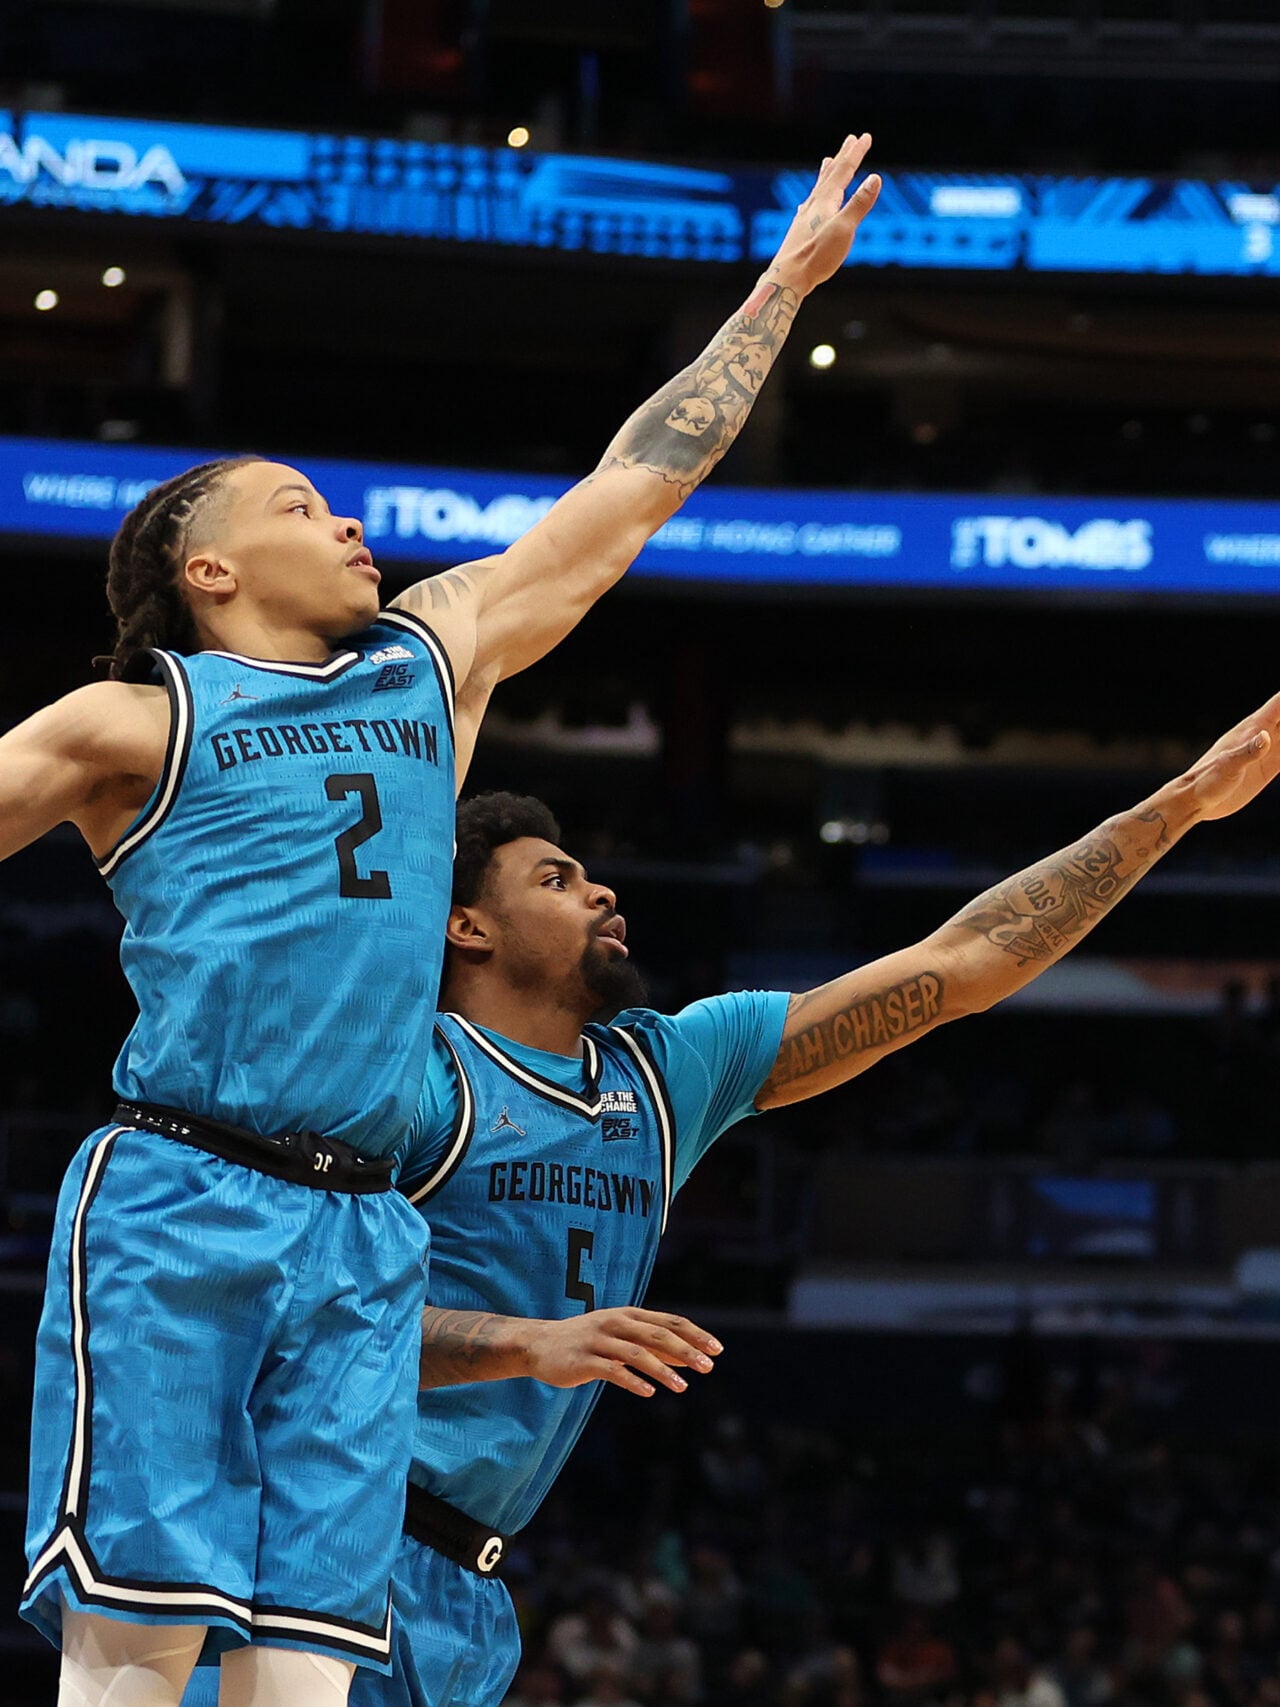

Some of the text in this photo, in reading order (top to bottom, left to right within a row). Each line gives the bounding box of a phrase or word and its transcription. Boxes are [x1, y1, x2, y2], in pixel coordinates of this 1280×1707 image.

[380, 664, 408, 676] BIG
[374, 675, 415, 687] EAST
[211, 718, 438, 771] GEORGETOWN
[324, 773, 392, 899] 2
[1020, 874, 1057, 911] STOP
[832, 973, 942, 1056] CHASER
[600, 1091, 635, 1102] BE THE
[600, 1101, 637, 1113] CHANGE
[602, 1118, 631, 1129] BIG
[602, 1127, 639, 1137] EAST
[477, 1536, 503, 1572] G
